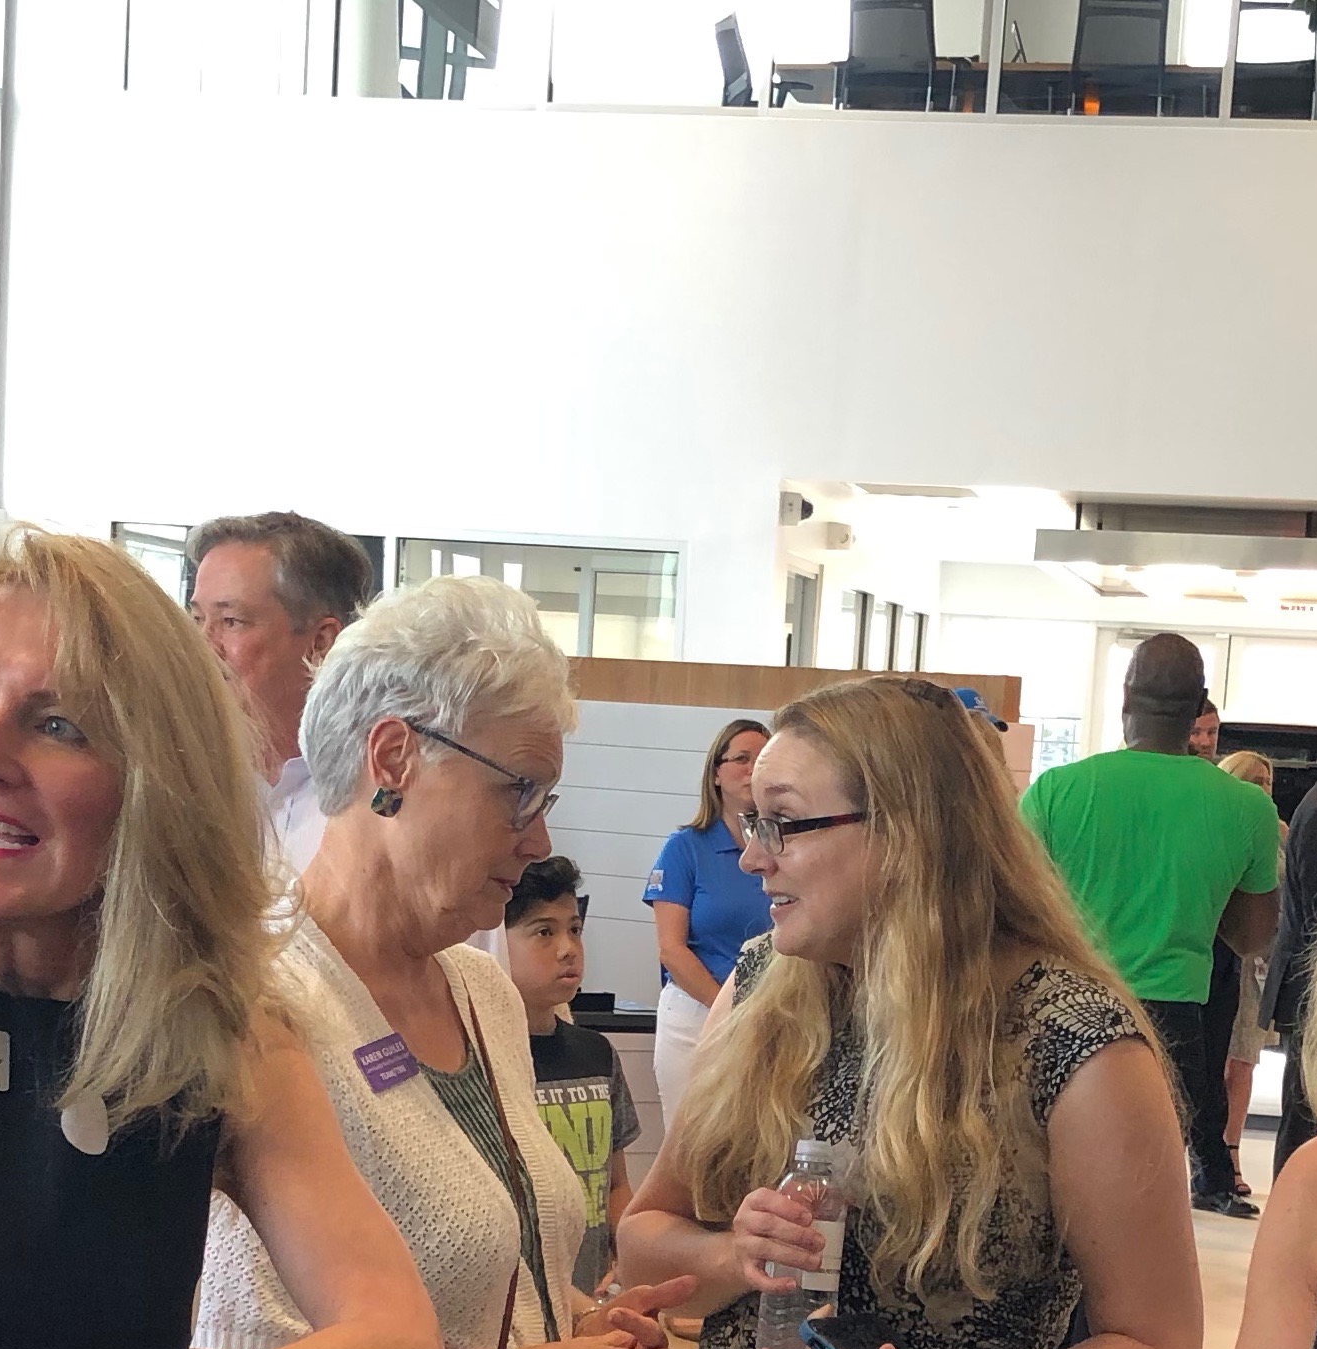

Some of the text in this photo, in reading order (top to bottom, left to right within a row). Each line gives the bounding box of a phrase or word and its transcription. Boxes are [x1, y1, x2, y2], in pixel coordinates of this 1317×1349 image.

[549, 1088, 564, 1104] IT
[567, 1086, 588, 1103] TO
[588, 1083, 611, 1101] THE
[538, 1101, 613, 1172] ND
